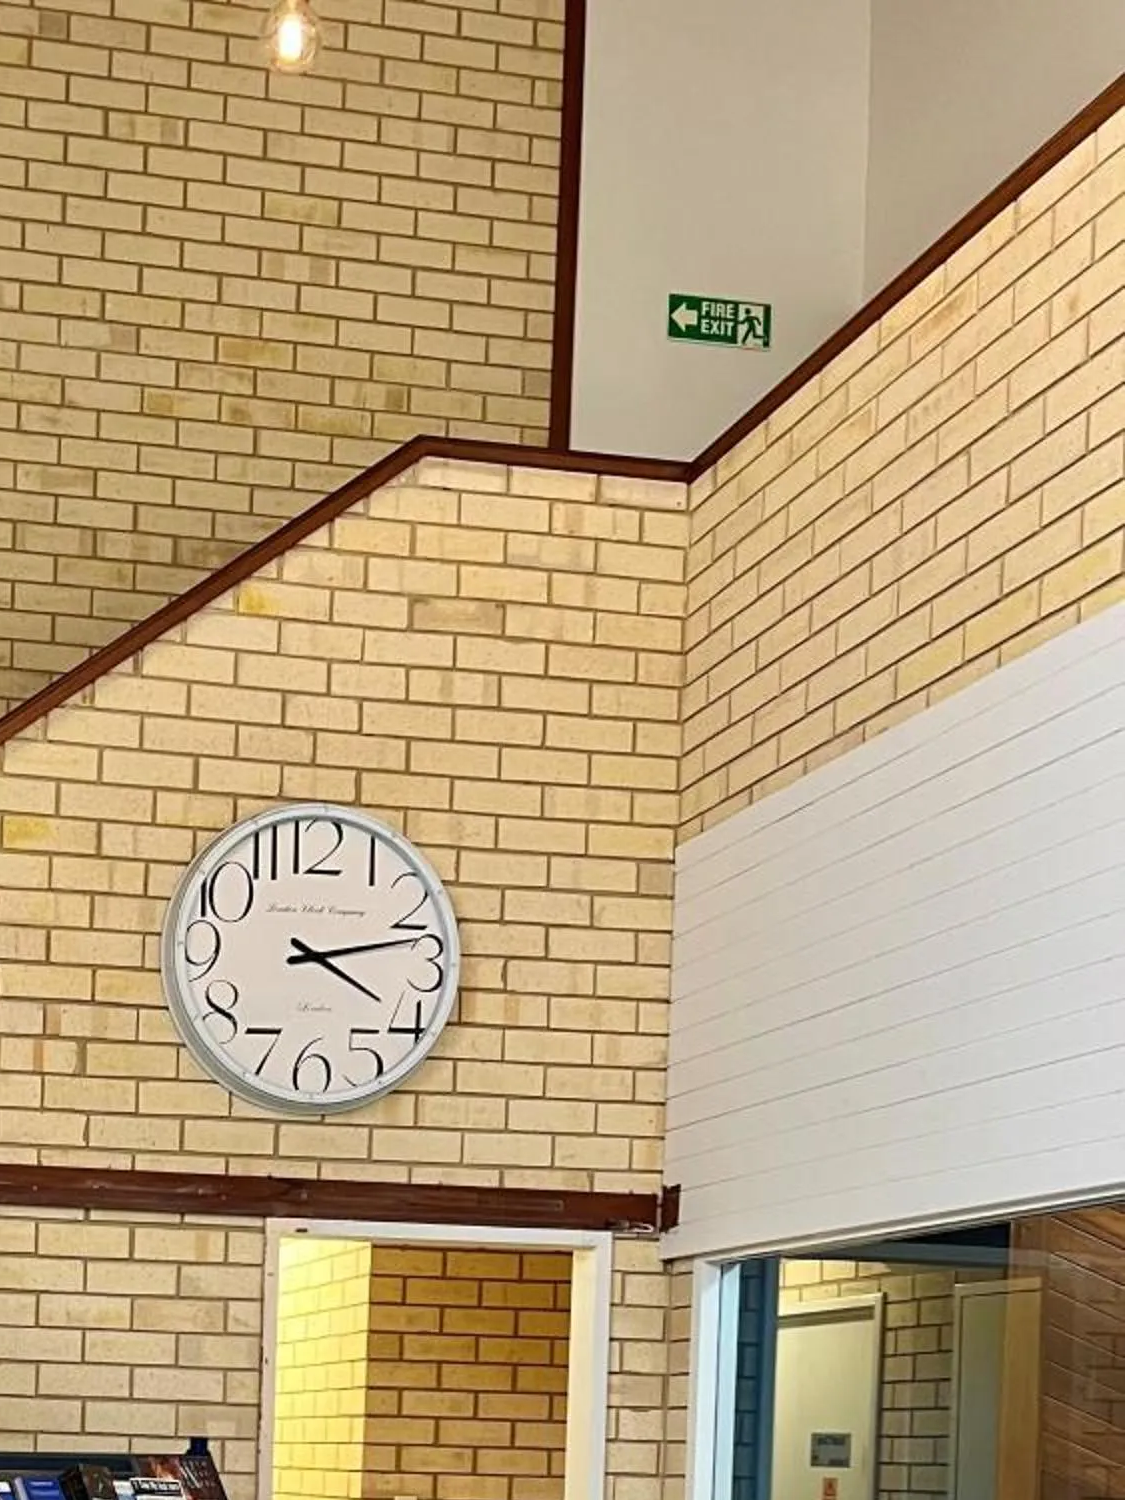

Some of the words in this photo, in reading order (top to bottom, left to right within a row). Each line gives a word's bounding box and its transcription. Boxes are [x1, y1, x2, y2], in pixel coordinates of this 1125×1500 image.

[701, 301, 736, 319] FIRE
[701, 319, 735, 336] EXIT
[253, 824, 278, 881] 11
[292, 819, 343, 876] 12
[368, 835, 376, 887] 1
[200, 861, 254, 923] 10
[390, 871, 428, 931] 2
[185, 919, 221, 983] 9
[407, 933, 444, 993] 3
[202, 980, 239, 1045] 8
[387, 990, 426, 1044] 4
[244, 1027, 283, 1076] 7
[292, 1037, 332, 1093] 6
[342, 1028, 384, 1087] 5
